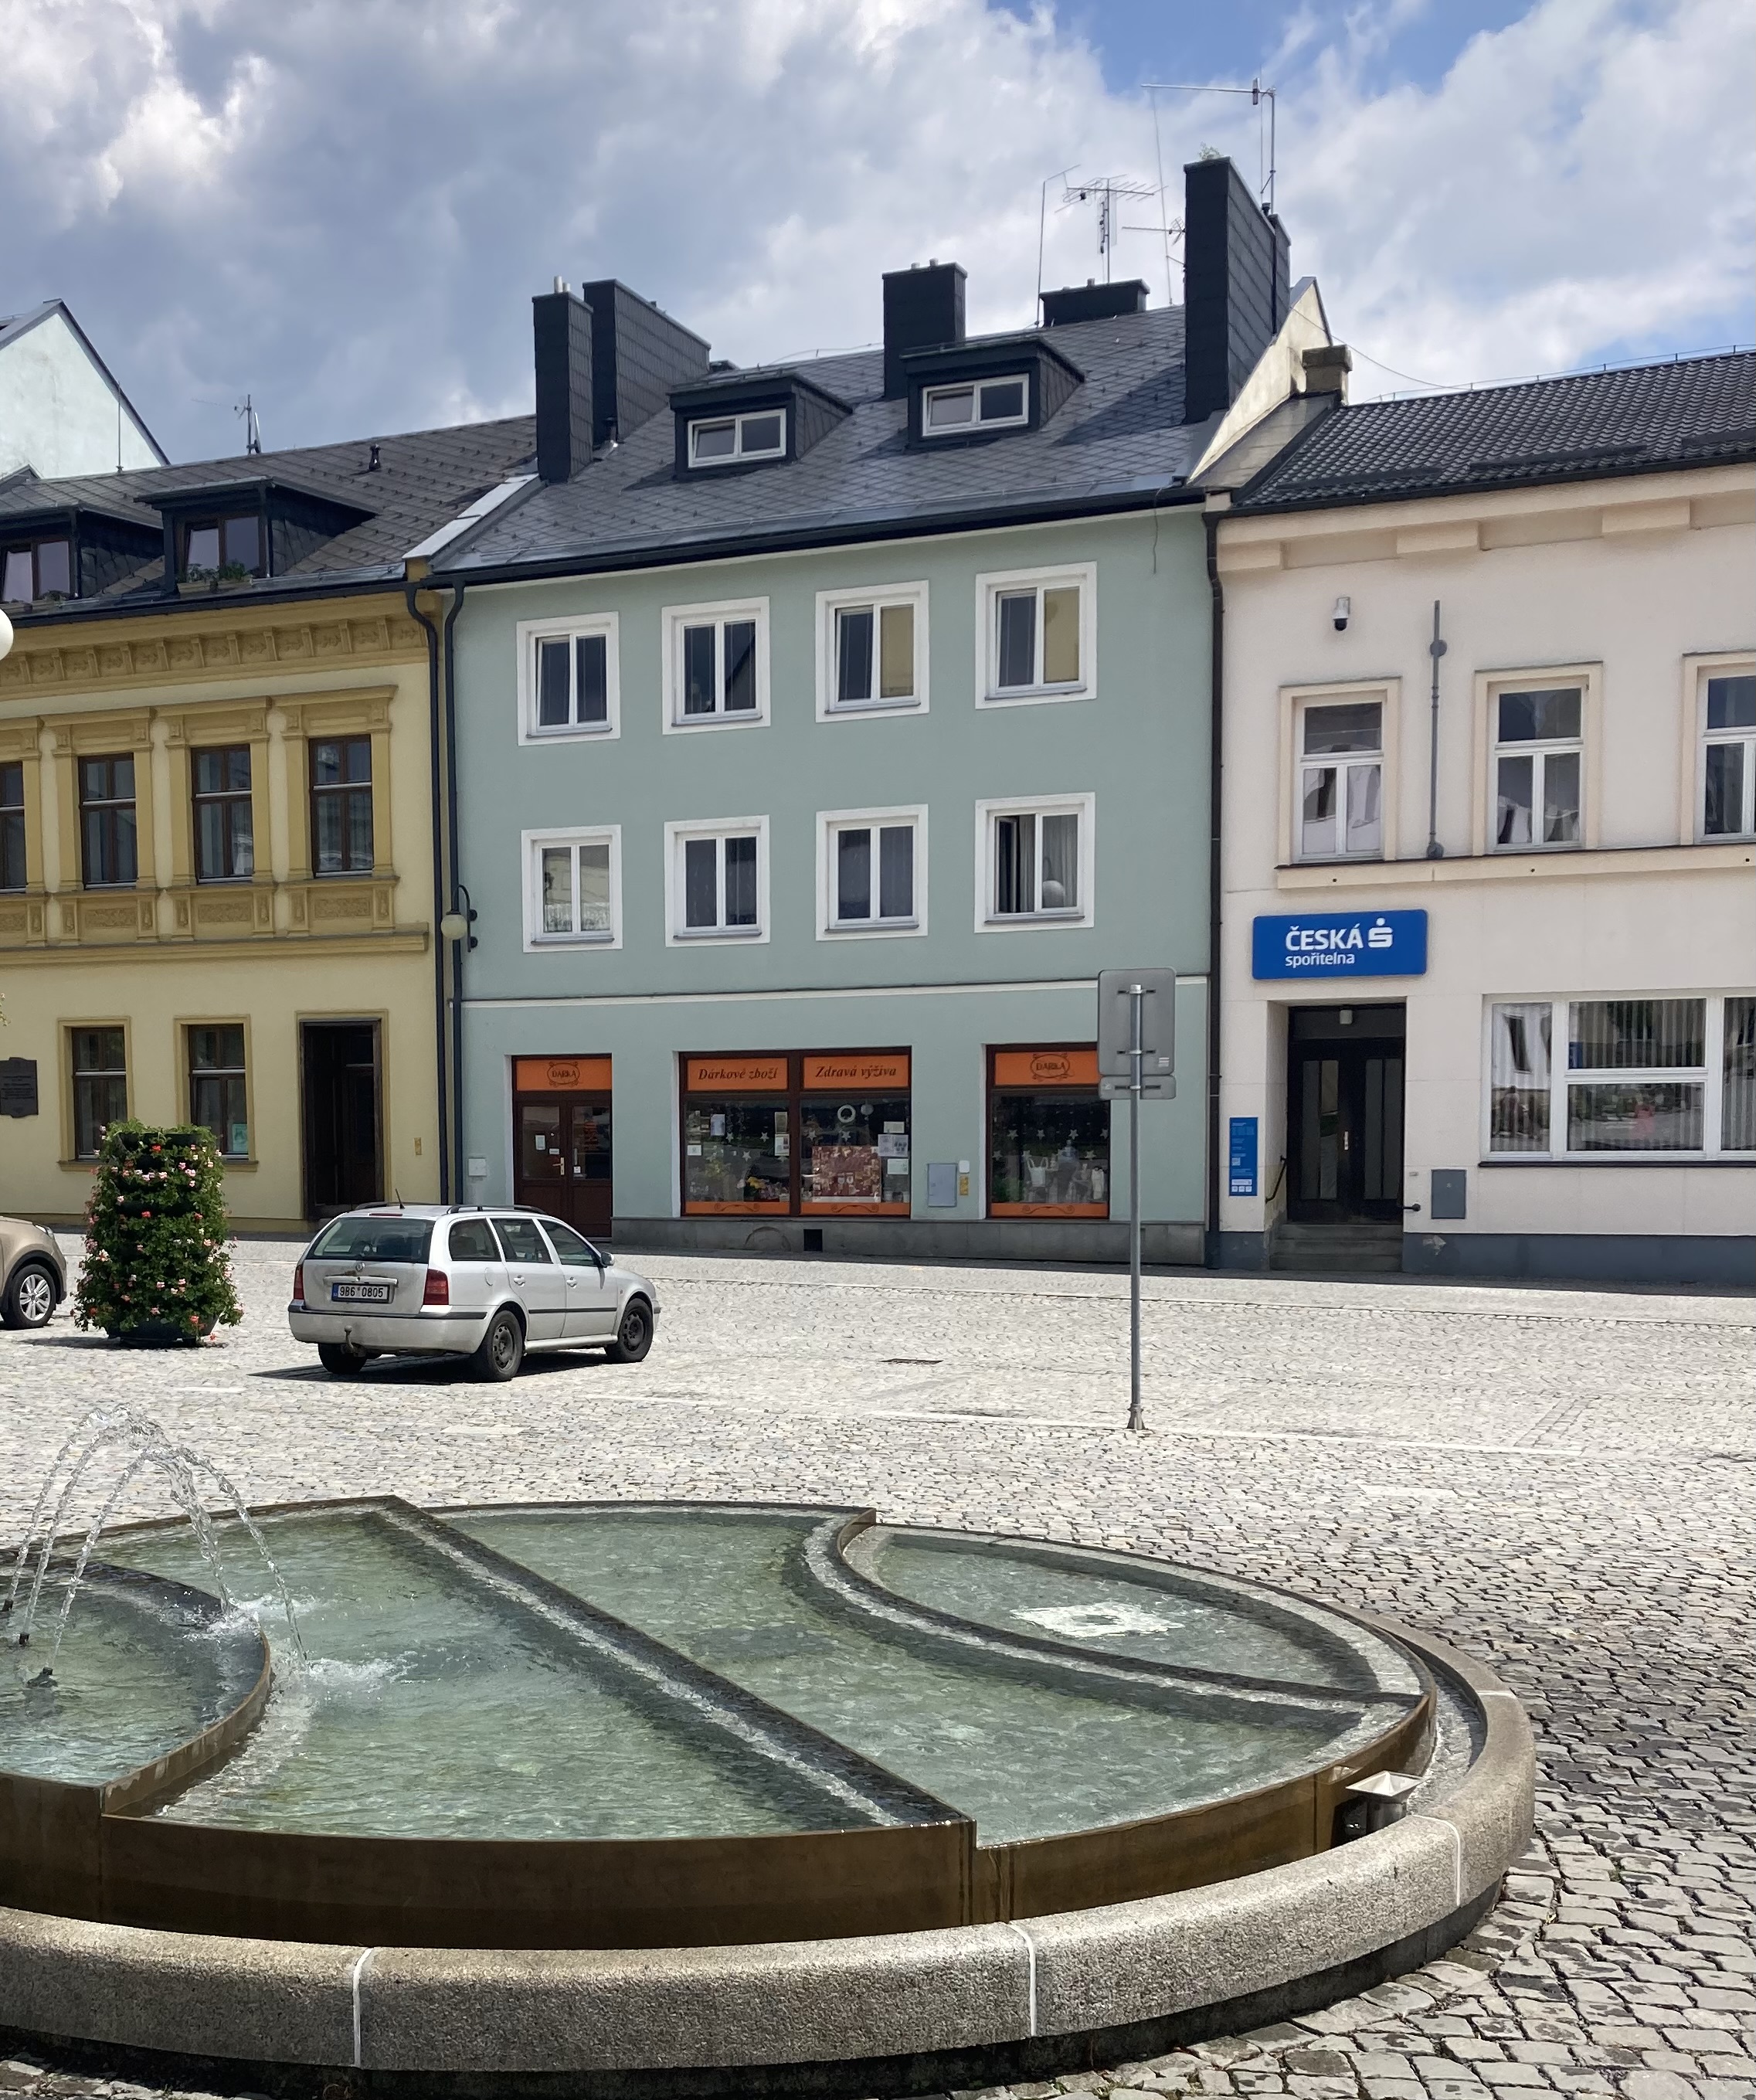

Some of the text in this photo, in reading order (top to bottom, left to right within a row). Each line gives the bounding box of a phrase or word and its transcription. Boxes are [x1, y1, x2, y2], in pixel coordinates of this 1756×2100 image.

[1286, 923, 1364, 951] ČESKÁ
[1286, 952, 1355, 968] spořitelna
[698, 1067, 778, 1080] Dárkové zboží
[815, 1065, 897, 1079] Zdravá výživa
[340, 1286, 355, 1296] 9B6
[362, 1287, 384, 1298] 0805
